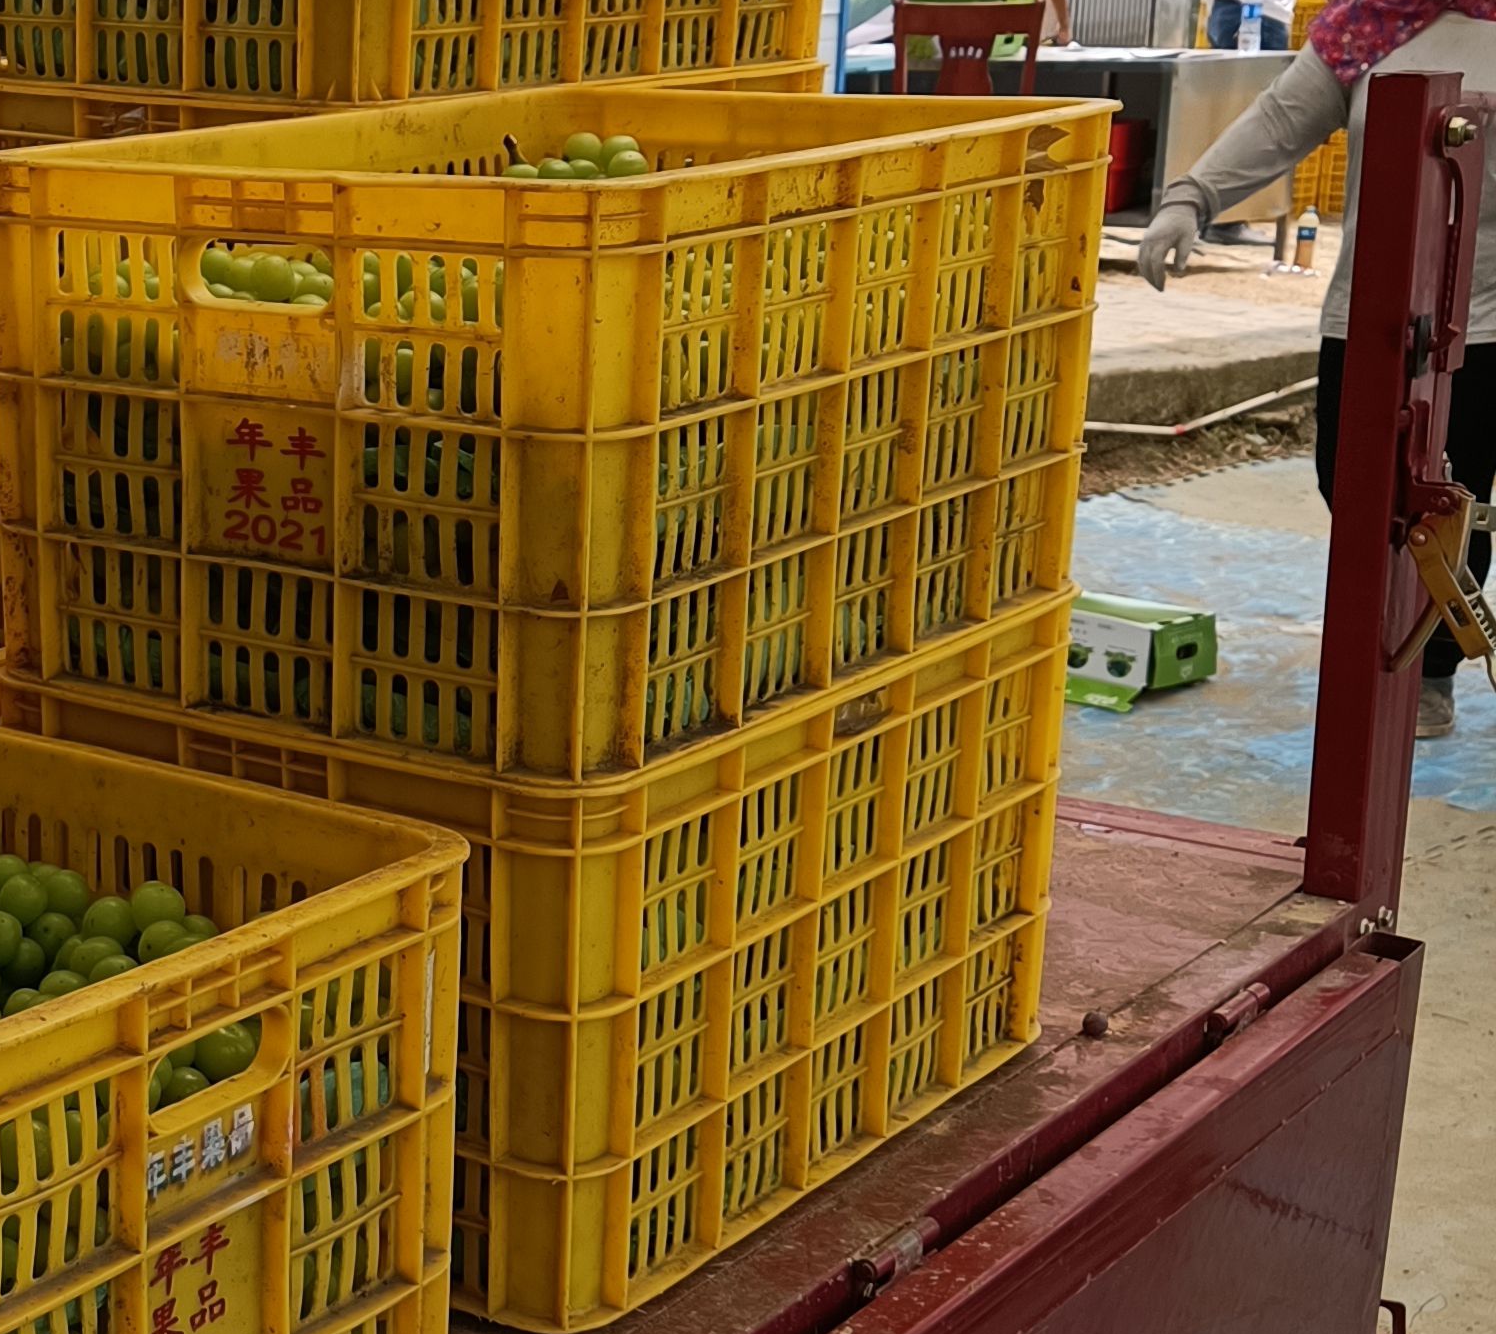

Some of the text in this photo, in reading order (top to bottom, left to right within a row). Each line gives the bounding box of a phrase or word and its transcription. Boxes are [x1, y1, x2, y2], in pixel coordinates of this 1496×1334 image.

[225, 417, 327, 471] 年丰
[227, 469, 324, 514] 果品
[223, 509, 326, 556] 2021
[148, 1222, 231, 1297] 年丰
